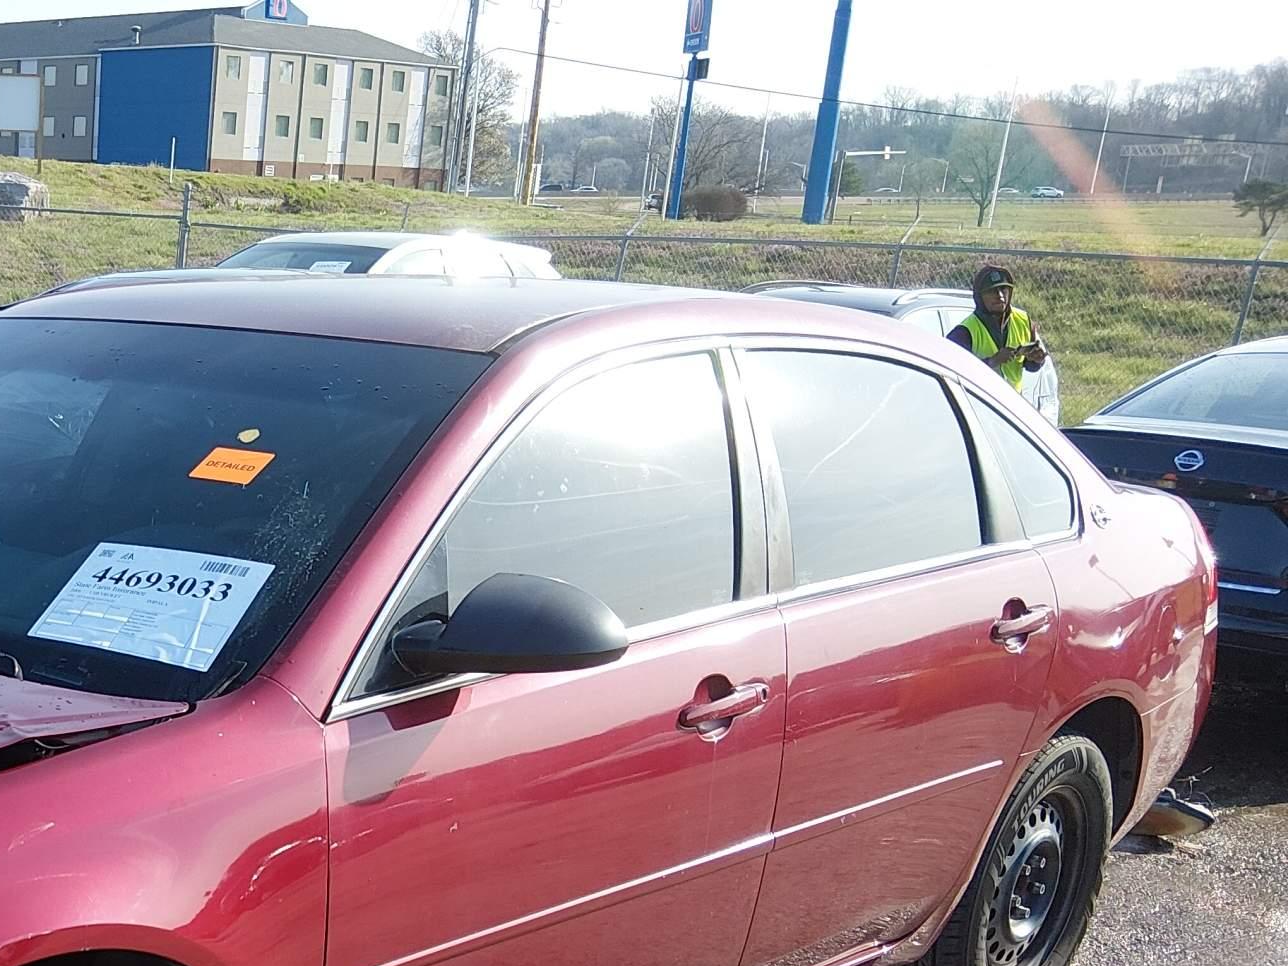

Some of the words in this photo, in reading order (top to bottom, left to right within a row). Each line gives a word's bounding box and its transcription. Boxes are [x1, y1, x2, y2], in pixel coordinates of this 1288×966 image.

[205, 460, 256, 472] DETAILED
[91, 566, 233, 602] 44693033
[1011, 758, 1065, 832] TOURING
